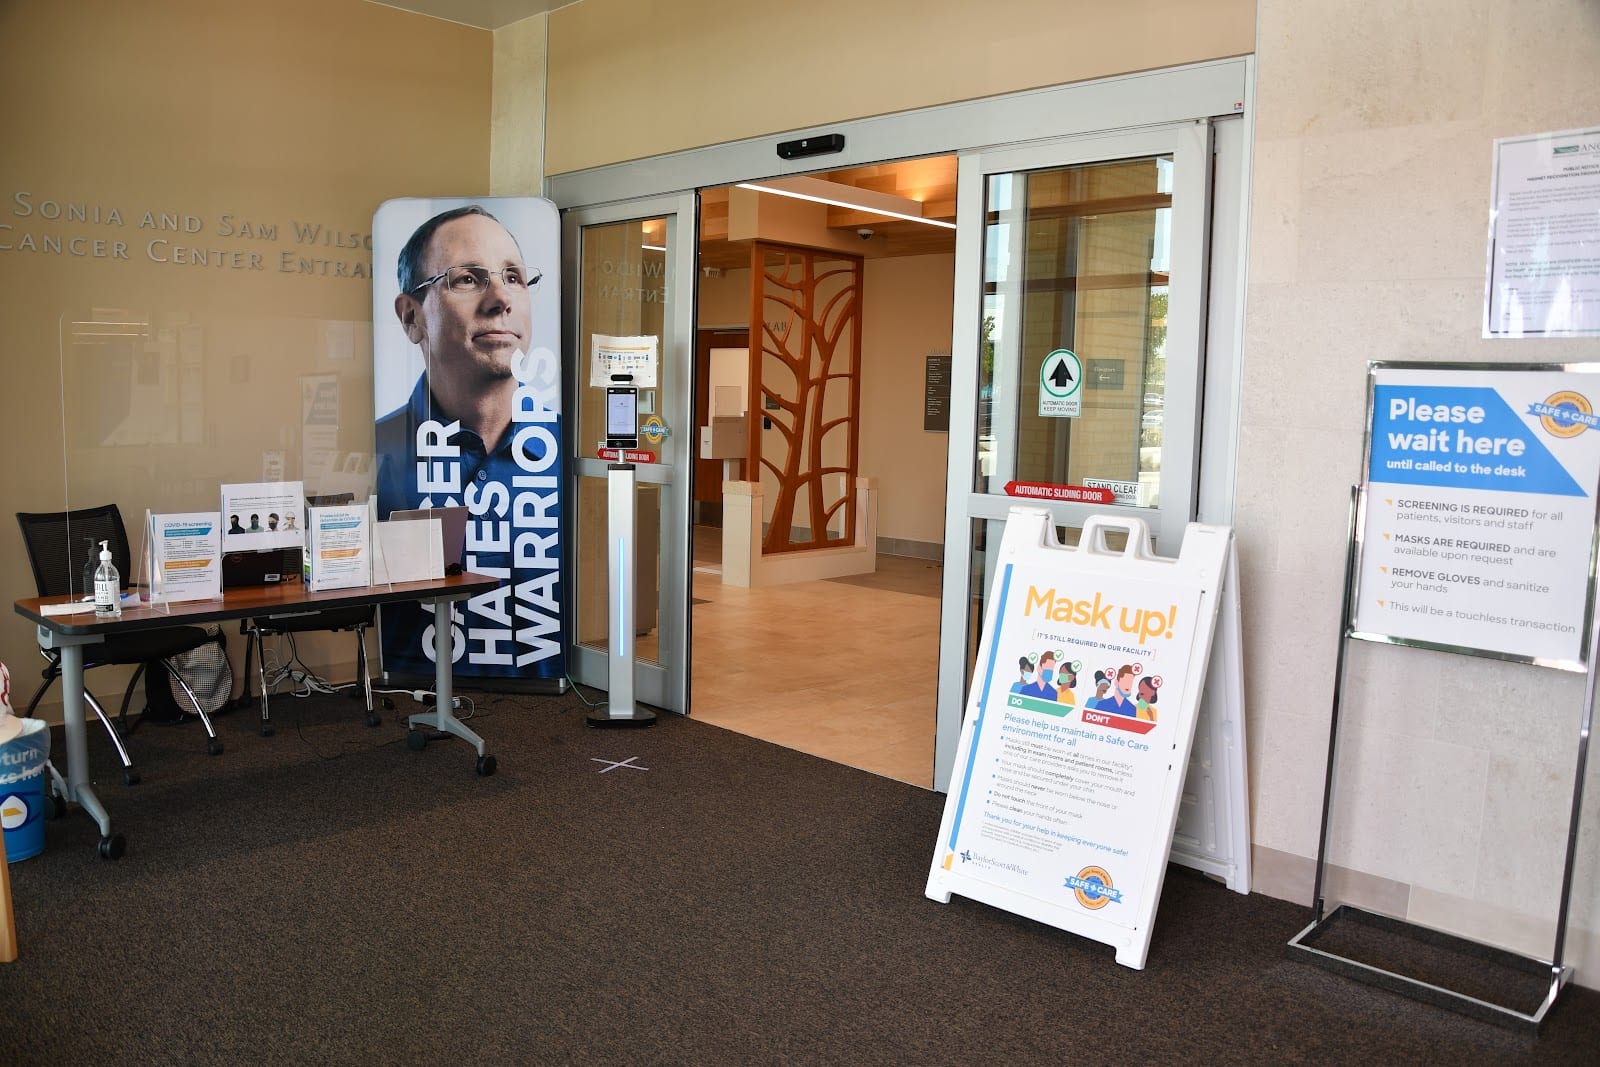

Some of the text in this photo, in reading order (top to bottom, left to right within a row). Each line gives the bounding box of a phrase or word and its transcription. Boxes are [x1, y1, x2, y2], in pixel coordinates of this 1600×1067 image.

[14, 191, 373, 251] SONIA AND SAM WILSO
[146, 239, 264, 270] CENTER
[277, 251, 373, 279] ENTRA
[1389, 397, 1485, 424] Please
[1535, 404, 1560, 417] SAFE
[1571, 412, 1598, 426] CARE
[1388, 428, 1526, 457] wait here
[1387, 459, 1526, 477] until called to the desk
[1015, 485, 1103, 501] AUTOMATIC SLIDING DOOR
[511, 348, 560, 667] WARRIORS
[1397, 500, 1563, 521] SCREENING IS REQUIRED for all
[1396, 512, 1535, 530] patients, visitors and staff
[1393, 546, 1513, 566] available upon request
[1395, 534, 1556, 558] MASKS ARE REQUIRED and are
[464, 481, 513, 665] HATES
[1392, 567, 1549, 594] REMOVE GLOVES and sanitize
[1391, 580, 1448, 594] your hands
[1024, 585, 1177, 644] Mask up!
[1390, 601, 1576, 633] This will be a touchless transaction
[1037, 632, 1049, 640] IT'S
[1050, 634, 1066, 643] STILL
[1067, 637, 1098, 648] REQUIRED
[1107, 644, 1121, 652] OUR
[1122, 647, 1152, 657] FACILITY
[1011, 697, 1022, 706] DO
[1086, 713, 1110, 725] DON'T
[1001, 723, 1076, 746] environment for all
[1004, 712, 1030, 725] Please
[1031, 719, 1049, 730] help
[1061, 726, 1097, 740] maintain
[1105, 735, 1125, 746] Safe
[1126, 739, 1149, 751] Care
[1003, 743, 1027, 753] including
[1046, 753, 1063, 761] rooms
[1074, 759, 1094, 769] patient
[1045, 770, 1074, 782] completely
[983, 811, 1001, 820] Thank
[1000, 816, 1012, 825] you
[1022, 822, 1036, 831] your
[1036, 826, 1050, 835] help
[1056, 832, 1082, 844] keeping
[1081, 840, 1112, 851] everyone
[1070, 878, 1090, 890] SAFE
[1097, 886, 1118, 898] CARE
